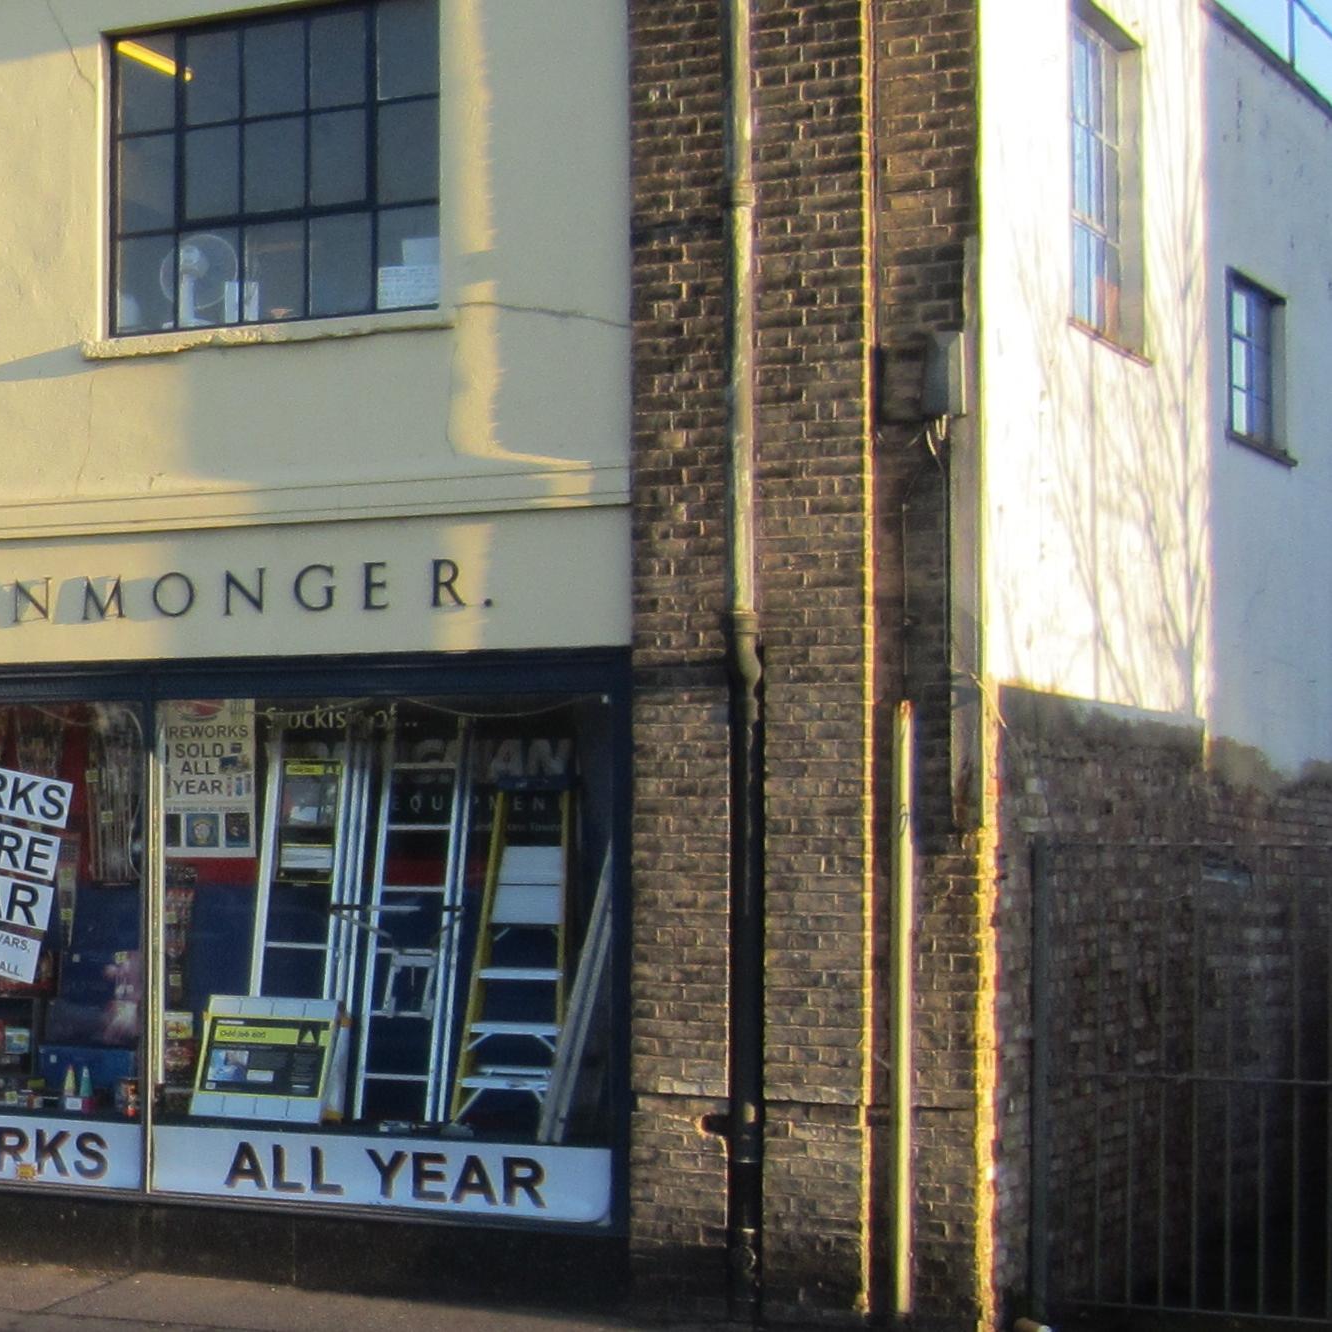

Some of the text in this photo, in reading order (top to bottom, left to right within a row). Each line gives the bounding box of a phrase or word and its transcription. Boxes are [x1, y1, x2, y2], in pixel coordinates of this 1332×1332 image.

[166, 724, 249, 739] IREWORKS
[175, 742, 224, 759] SOLD
[180, 760, 216, 776] ALL
[173, 779, 223, 795] YEAR
[223, 1140, 547, 1209] ALL YEAR
